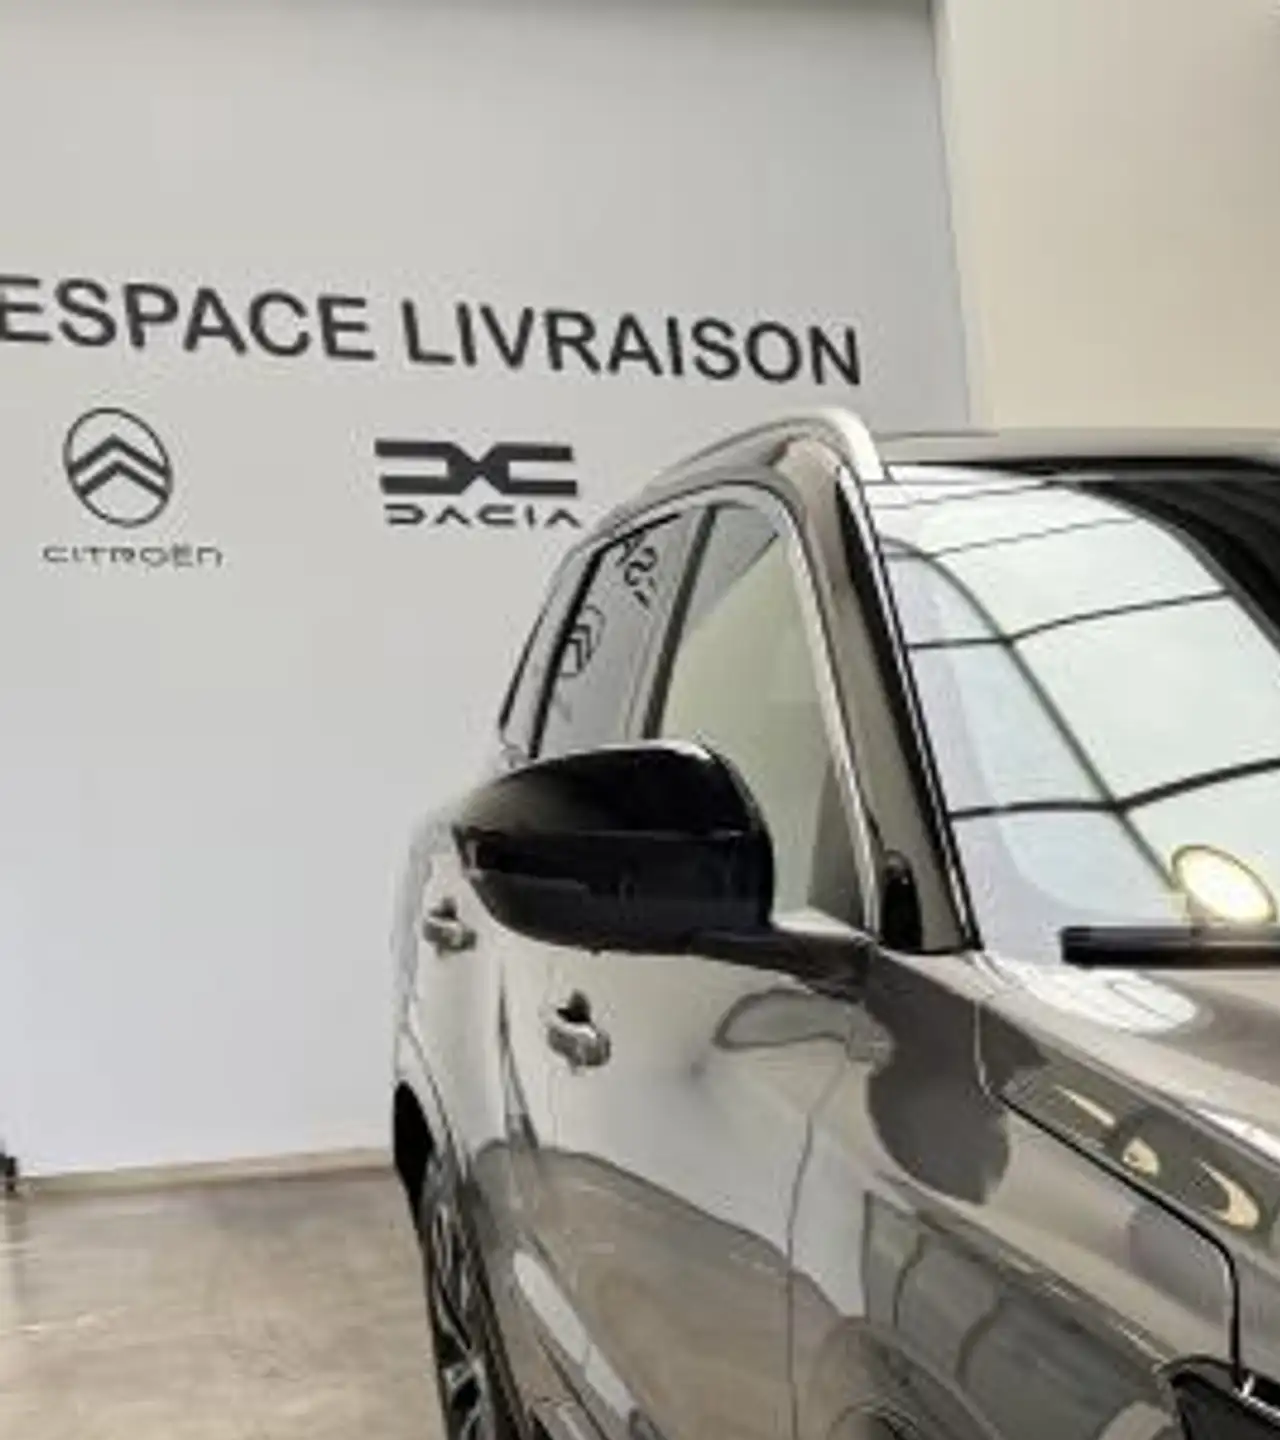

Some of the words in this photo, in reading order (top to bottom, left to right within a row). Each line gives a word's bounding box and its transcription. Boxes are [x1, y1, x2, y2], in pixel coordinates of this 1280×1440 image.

[0, 273, 377, 363] ESPACE
[400, 298, 863, 389] LIVRAISON
[383, 502, 583, 529] DACIA
